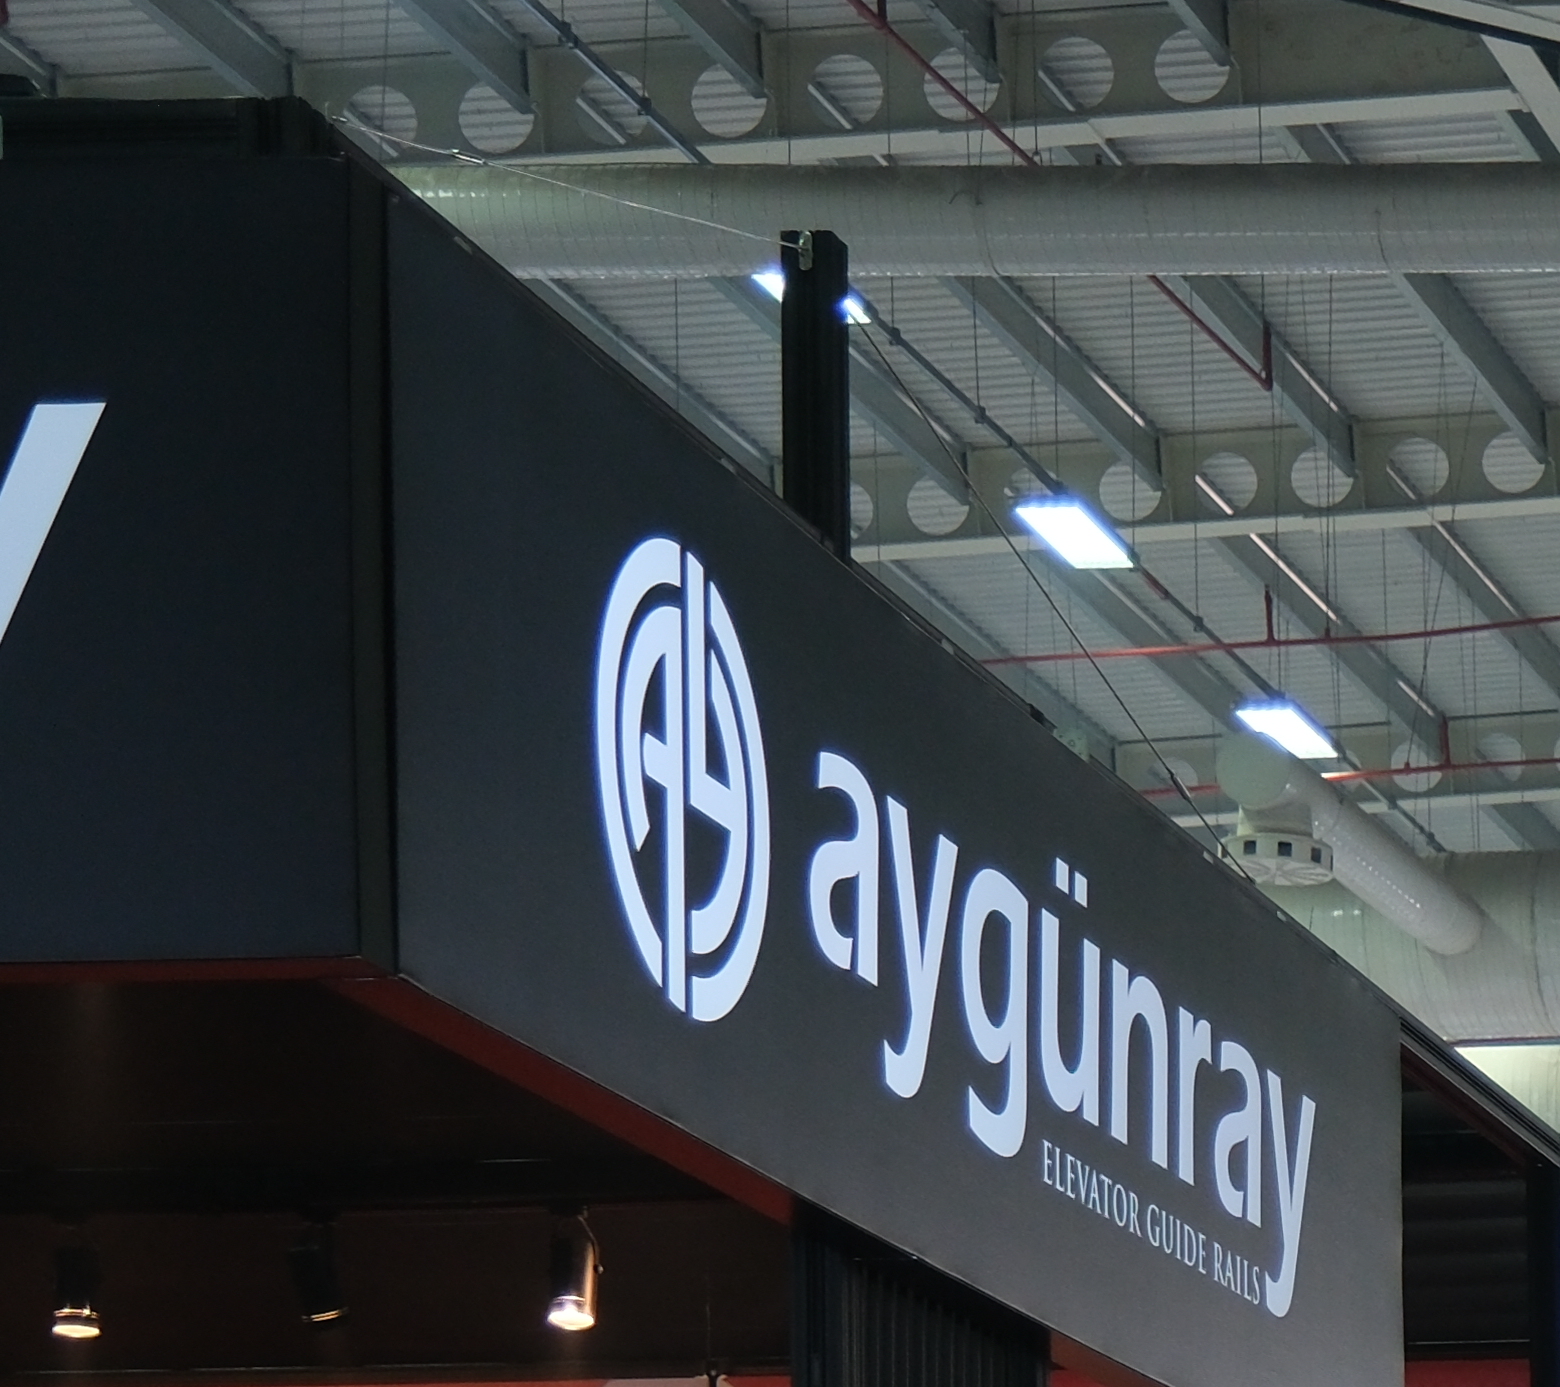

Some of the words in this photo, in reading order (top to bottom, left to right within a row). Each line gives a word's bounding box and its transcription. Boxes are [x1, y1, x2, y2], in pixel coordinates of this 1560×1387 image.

[808, 750, 1316, 1319] aygünray
[1042, 1138, 1141, 1239] ELEVATOR
[1146, 1203, 1207, 1275] GUIDE
[1213, 1241, 1261, 1306] RAILS
